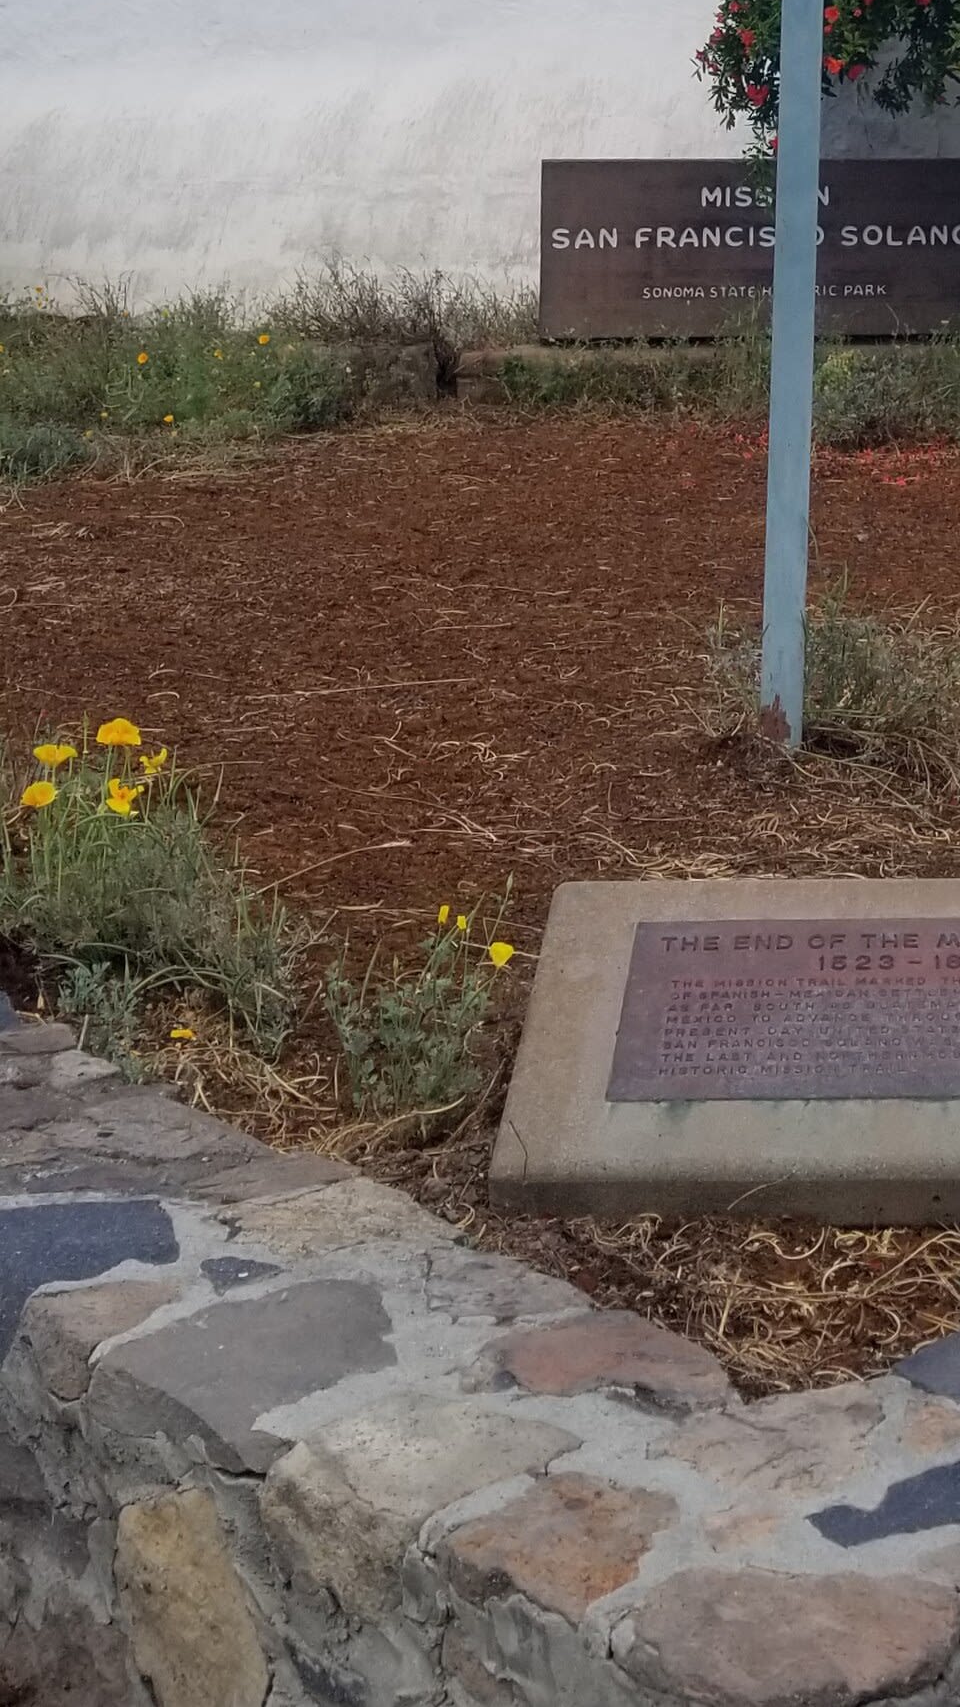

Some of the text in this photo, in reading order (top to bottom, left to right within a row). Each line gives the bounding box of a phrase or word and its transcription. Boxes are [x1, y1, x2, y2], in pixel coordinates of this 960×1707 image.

[701, 186, 830, 208] MISSN
[551, 227, 619, 249] SAN
[635, 226, 825, 249] FRANCIS
[643, 284, 887, 299] SONOMA STATE HRIC PARK
[661, 935, 721, 951] THE
[734, 935, 793, 950] END
[808, 934, 847, 949] OF
[861, 933, 920, 949] THE
[671, 979, 704, 989] THE
[714, 978, 787, 988] MISSION
[796, 977, 847, 987] TRAIL
[855, 976, 926, 986] MARKED
[671, 992, 692, 1001] OF
[667, 1003, 689, 1012] AS
[700, 1002, 733, 1012] FAR
[753, 1002, 815, 1012] SOUTH
[666, 1015, 736, 1024] MEXICO
[753, 1014, 771, 1023] TO
[784, 1013, 871, 1023] ADVANCE
[664, 1027, 751, 1037] PRESENT
[767, 1026, 803, 1036] DAY
[663, 1040, 697, 1050] SAN
[708, 1039, 810, 1049] FRANCISCO
[823, 1037, 901, 1047] SOLANO
[661, 1053, 695, 1062] THE
[706, 1052, 751, 1062] LAST
[767, 1051, 802, 1061] AND
[659, 1065, 747, 1076] HISTORIC
[760, 1064, 840, 1074] MISSION
